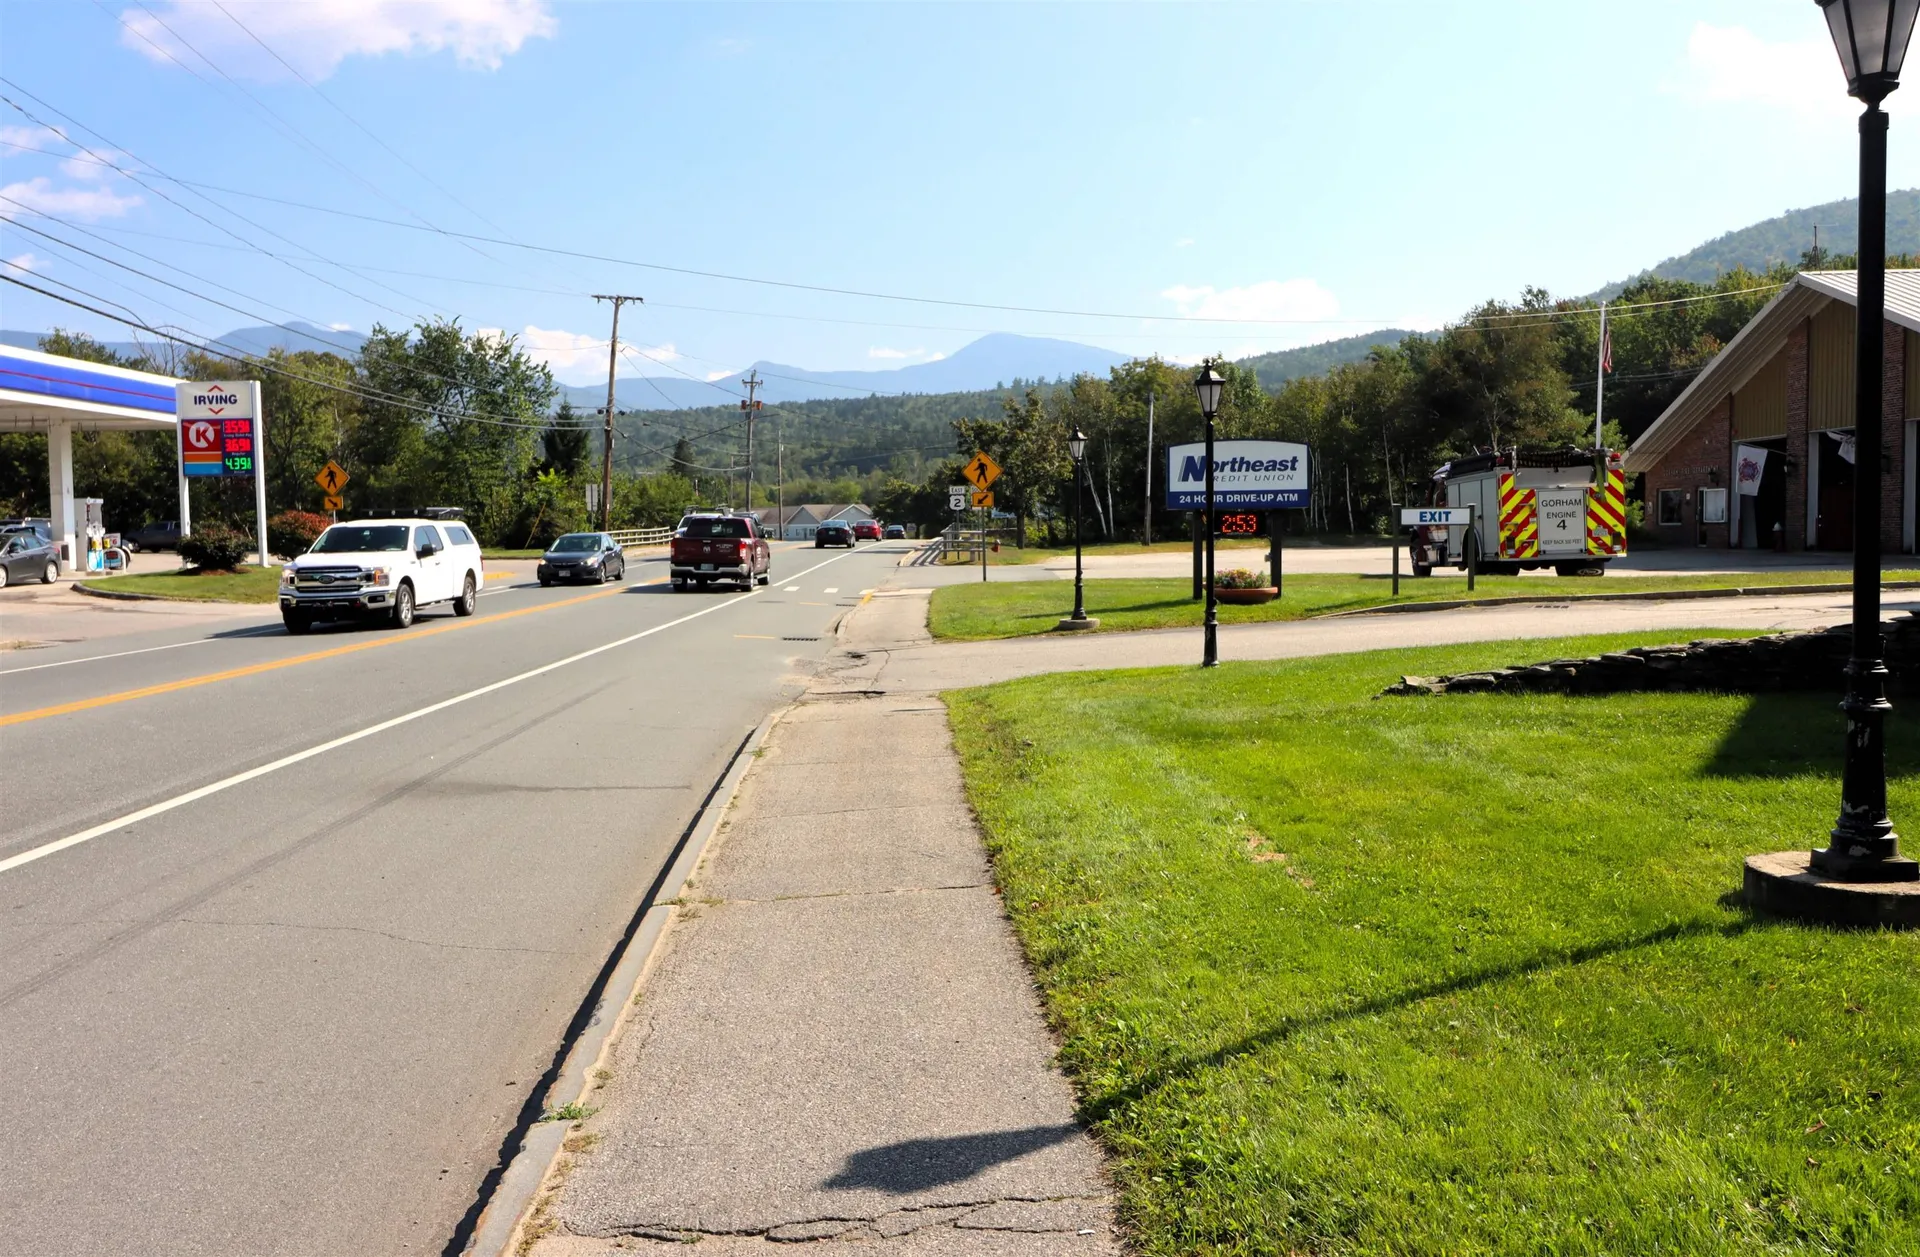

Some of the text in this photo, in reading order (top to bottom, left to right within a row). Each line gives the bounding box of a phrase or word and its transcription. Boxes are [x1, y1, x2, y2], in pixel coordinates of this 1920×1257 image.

[194, 394, 238, 405] IRVING
[1178, 455, 1298, 482] Northeast
[954, 498, 961, 507] 2
[1179, 495, 1191, 503] 24
[1226, 493, 1274, 502] DRIVE-UP
[1276, 493, 1298, 501] ATM
[1541, 498, 1582, 507] GORHAM
[1419, 511, 1451, 522] EXIT
[1546, 511, 1577, 519] ENGINE
[1222, 515, 1256, 532] 2:53
[1556, 519, 1567, 530] 4
